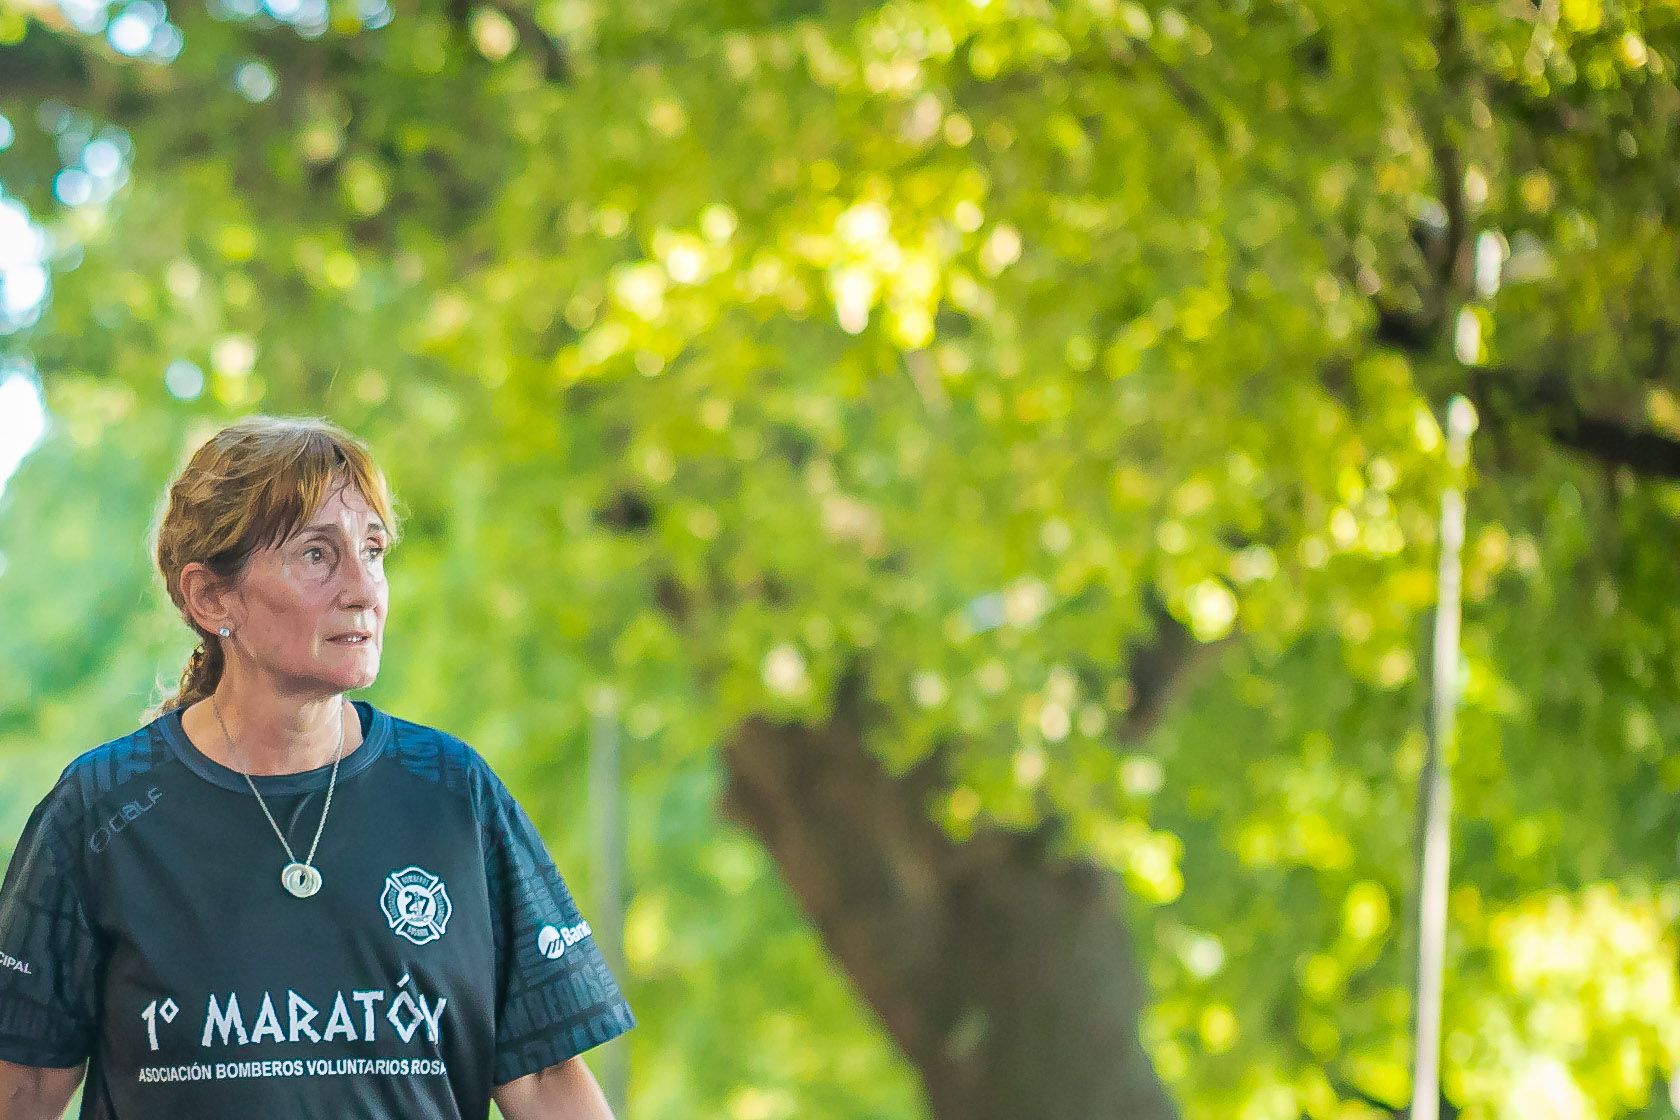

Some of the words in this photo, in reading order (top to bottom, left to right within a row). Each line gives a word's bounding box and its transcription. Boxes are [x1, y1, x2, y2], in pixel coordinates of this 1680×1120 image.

[404, 890, 430, 917] 27
[138, 1061, 212, 1083] ASOCIACIÓN
[215, 1060, 304, 1079] BOMBEROS
[306, 1058, 410, 1077] VOLUNTARIOS
